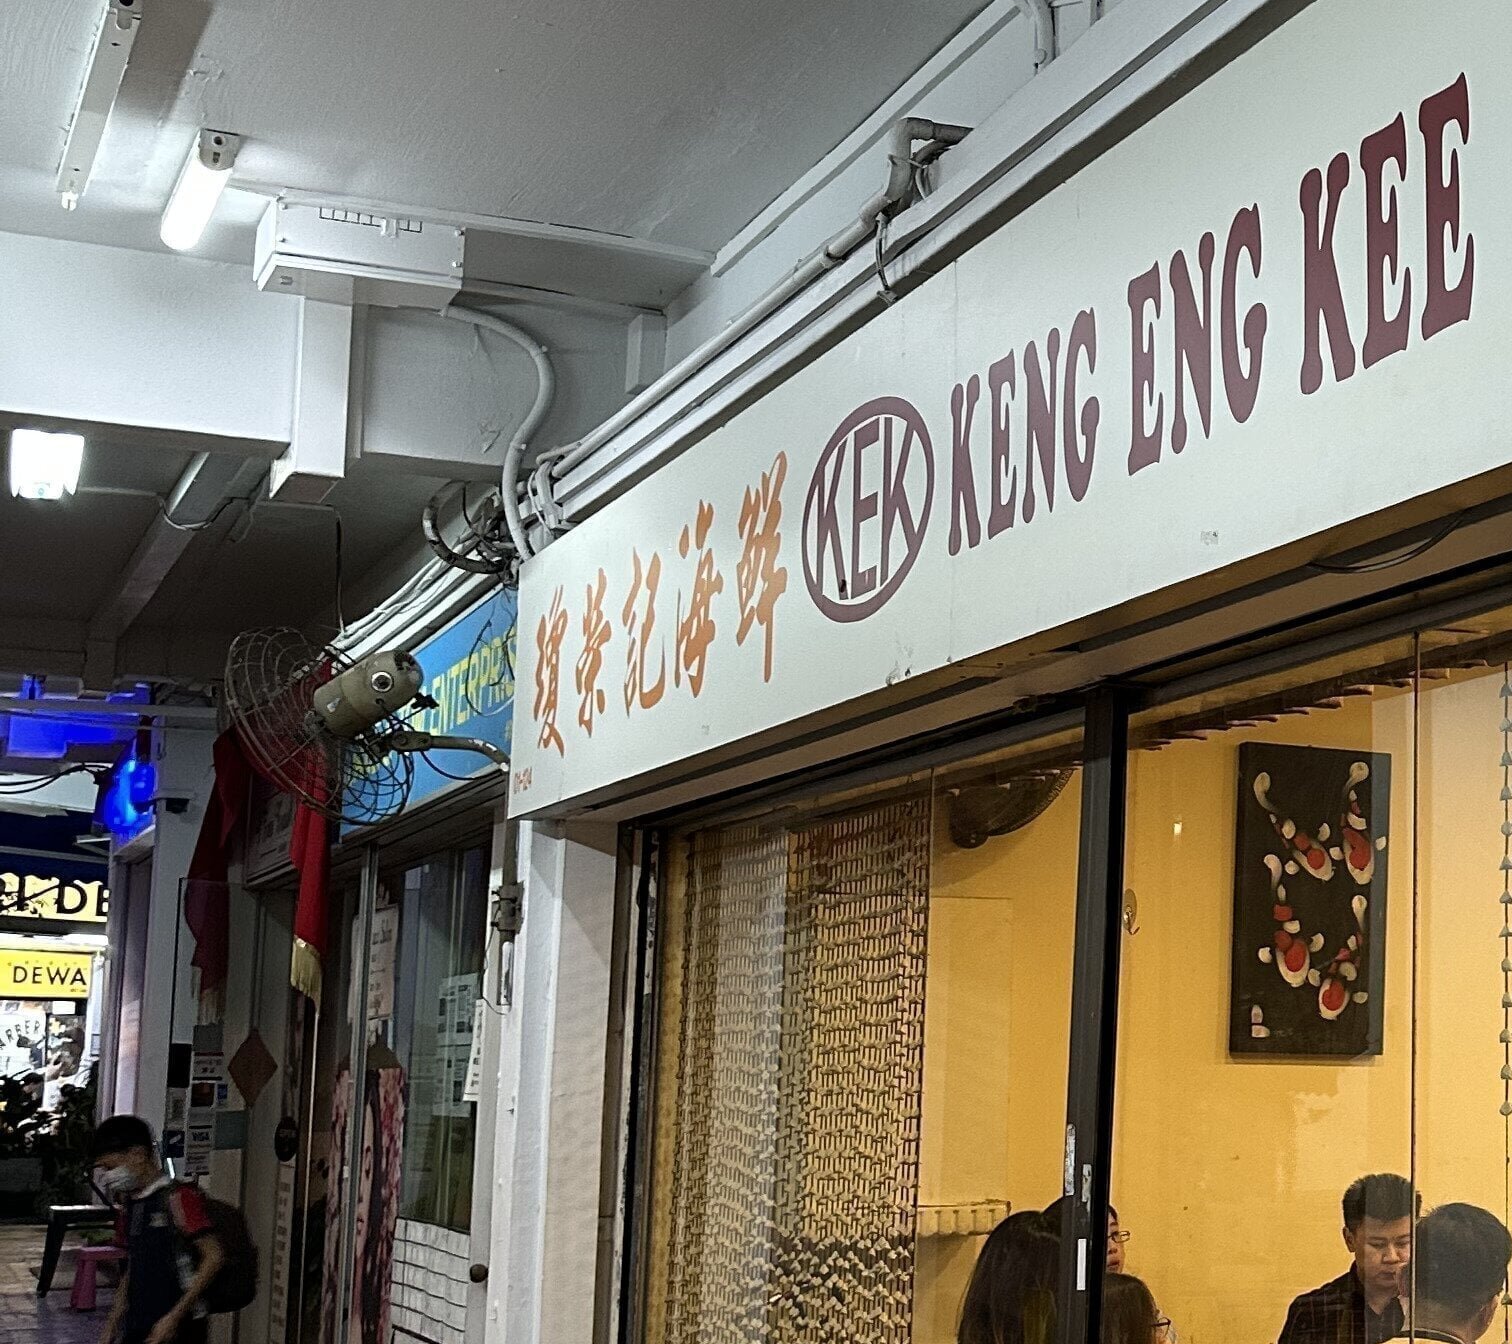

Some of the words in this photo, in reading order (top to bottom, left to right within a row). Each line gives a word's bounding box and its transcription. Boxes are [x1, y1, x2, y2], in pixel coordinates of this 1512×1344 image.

[948, 306, 1100, 557] KENG
[1127, 202, 1268, 476] ENG
[1299, 71, 1475, 395] KEE
[812, 413, 922, 602] KEK
[13, 965, 87, 986] DEWA
